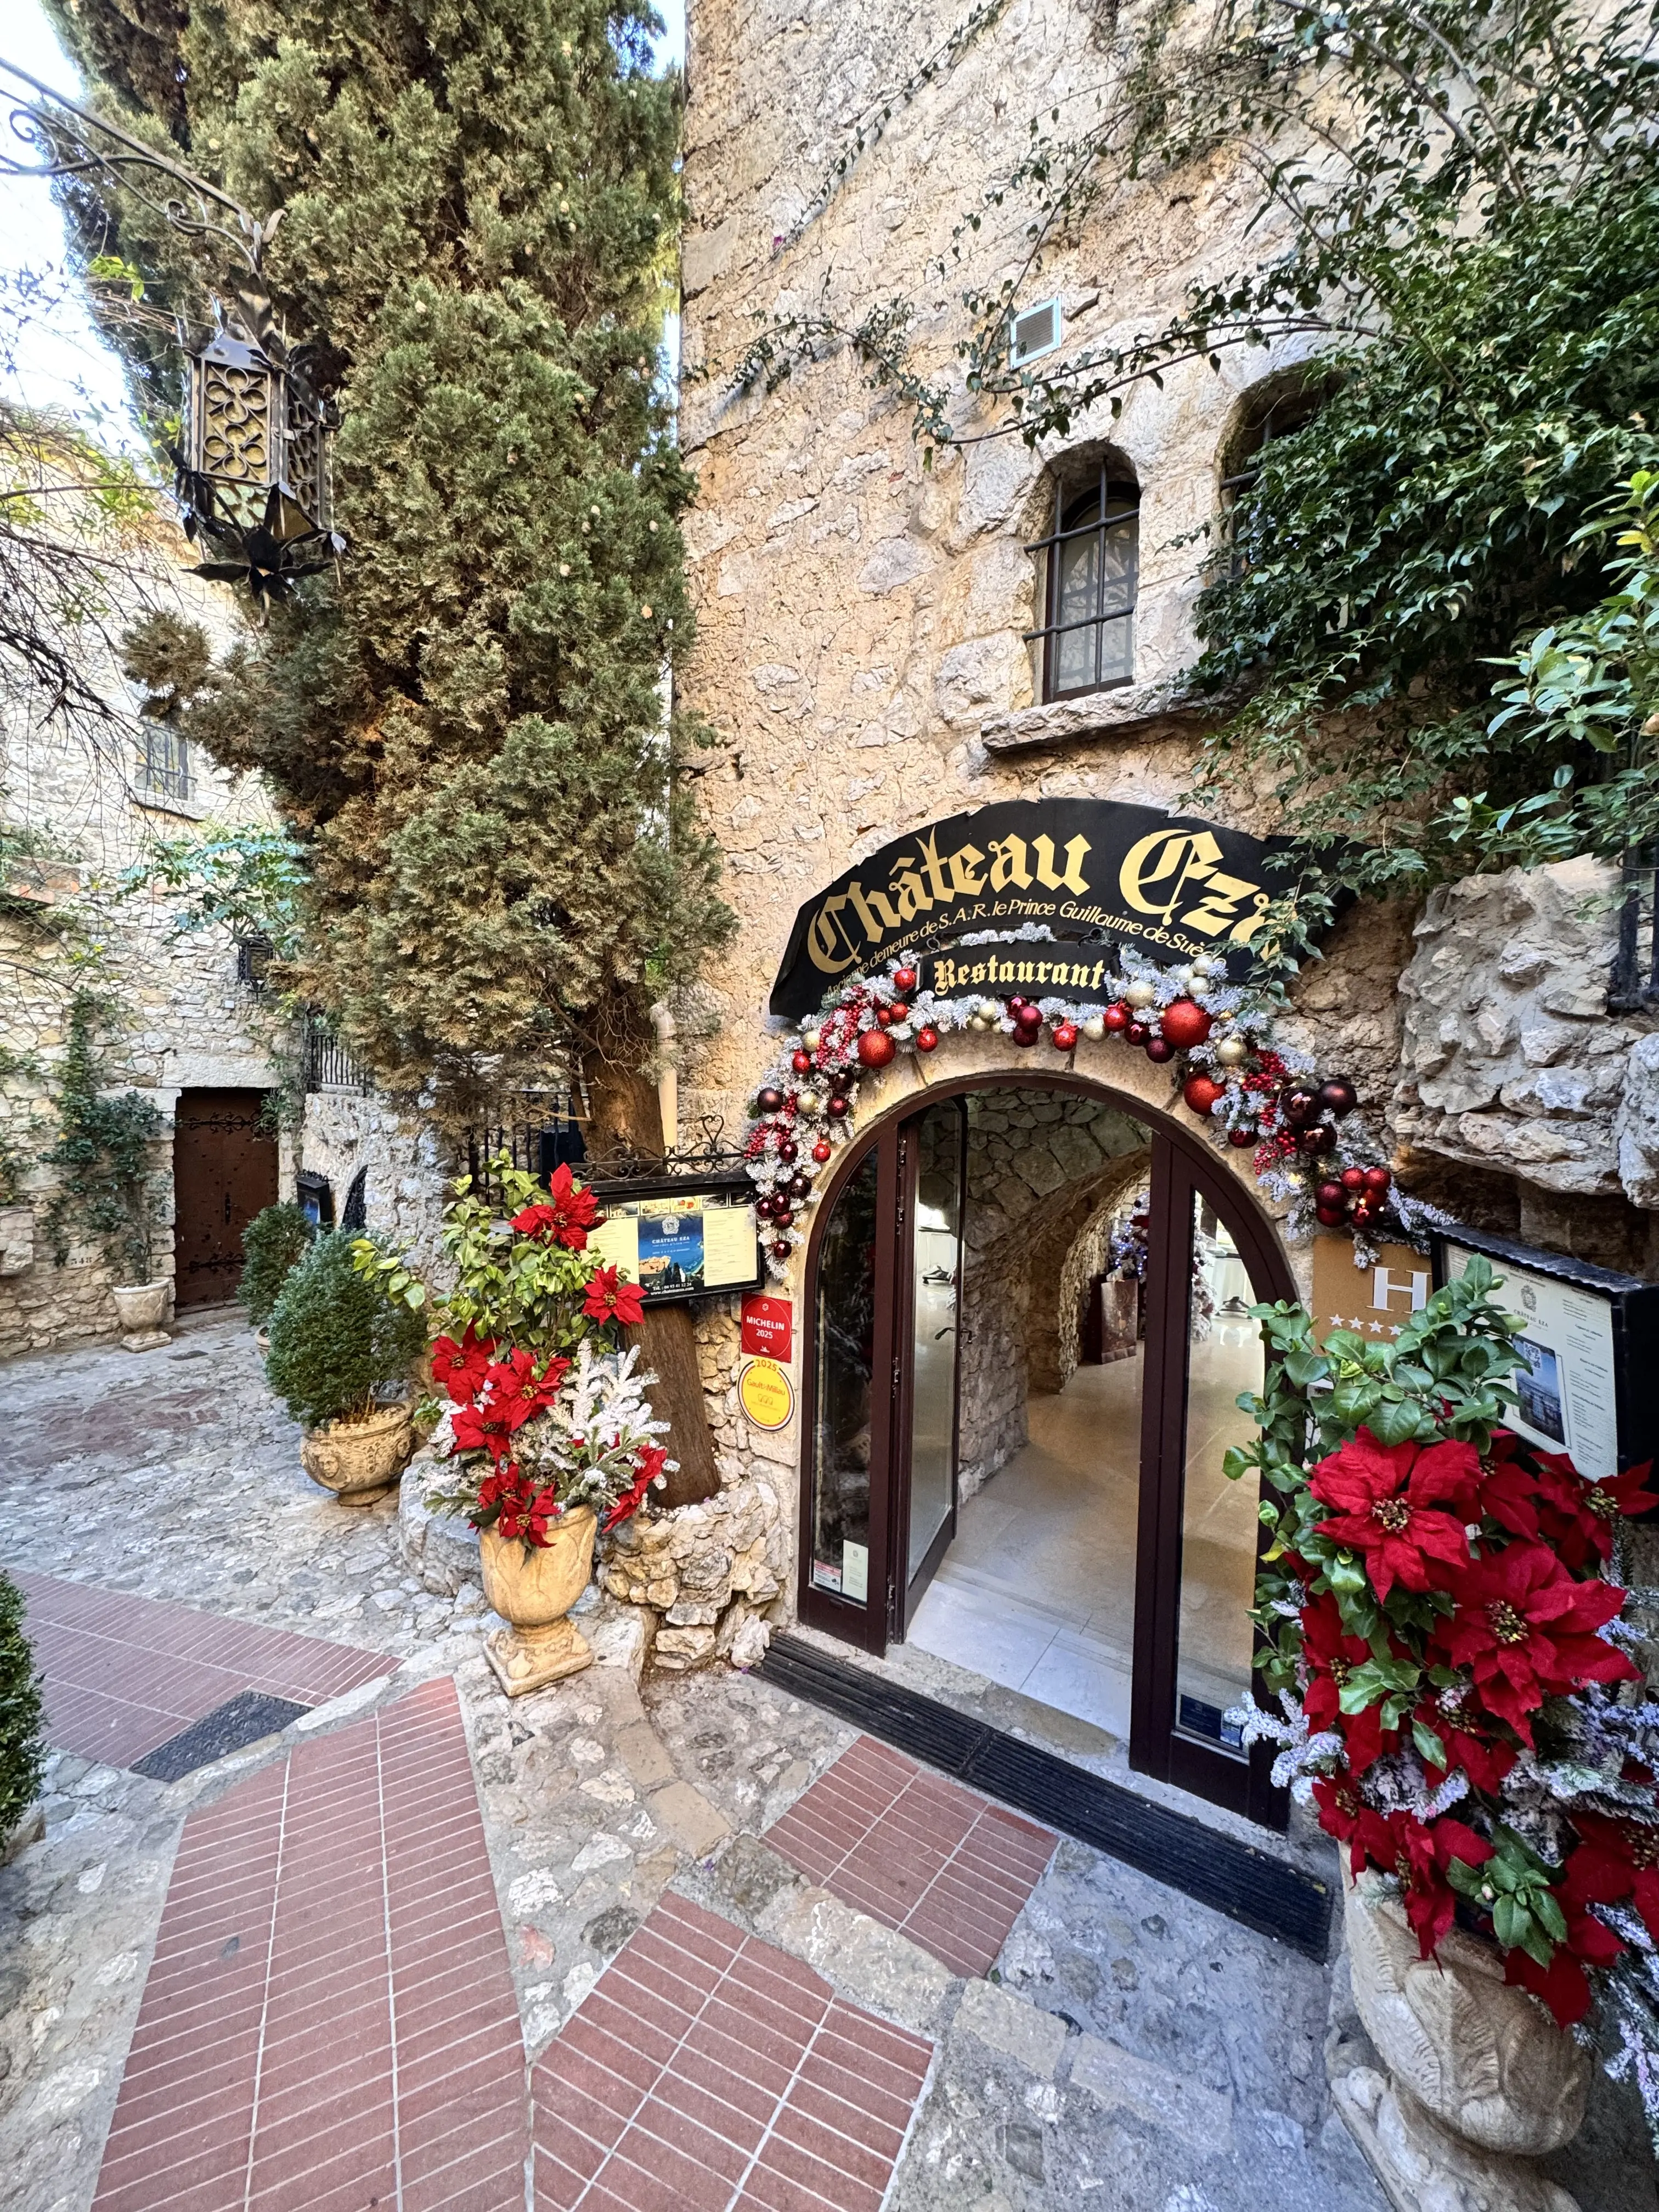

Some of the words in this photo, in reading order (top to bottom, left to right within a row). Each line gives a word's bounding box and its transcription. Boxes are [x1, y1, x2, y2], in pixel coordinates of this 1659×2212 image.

[808, 825, 1092, 973] Château
[870, 930, 919, 968] demeure
[919, 921, 939, 938] de
[992, 901, 1007, 916] le
[1007, 899, 1056, 916] Prince
[1059, 901, 1143, 935] Guillaume
[1143, 927, 1170, 944] de
[934, 955, 1105, 996] Restaurant
[1365, 1265, 1432, 1314] H
[746, 1315, 785, 1331] MICHELIN
[756, 1328, 773, 1339] 2025
[755, 1359, 777, 1372] 2025
